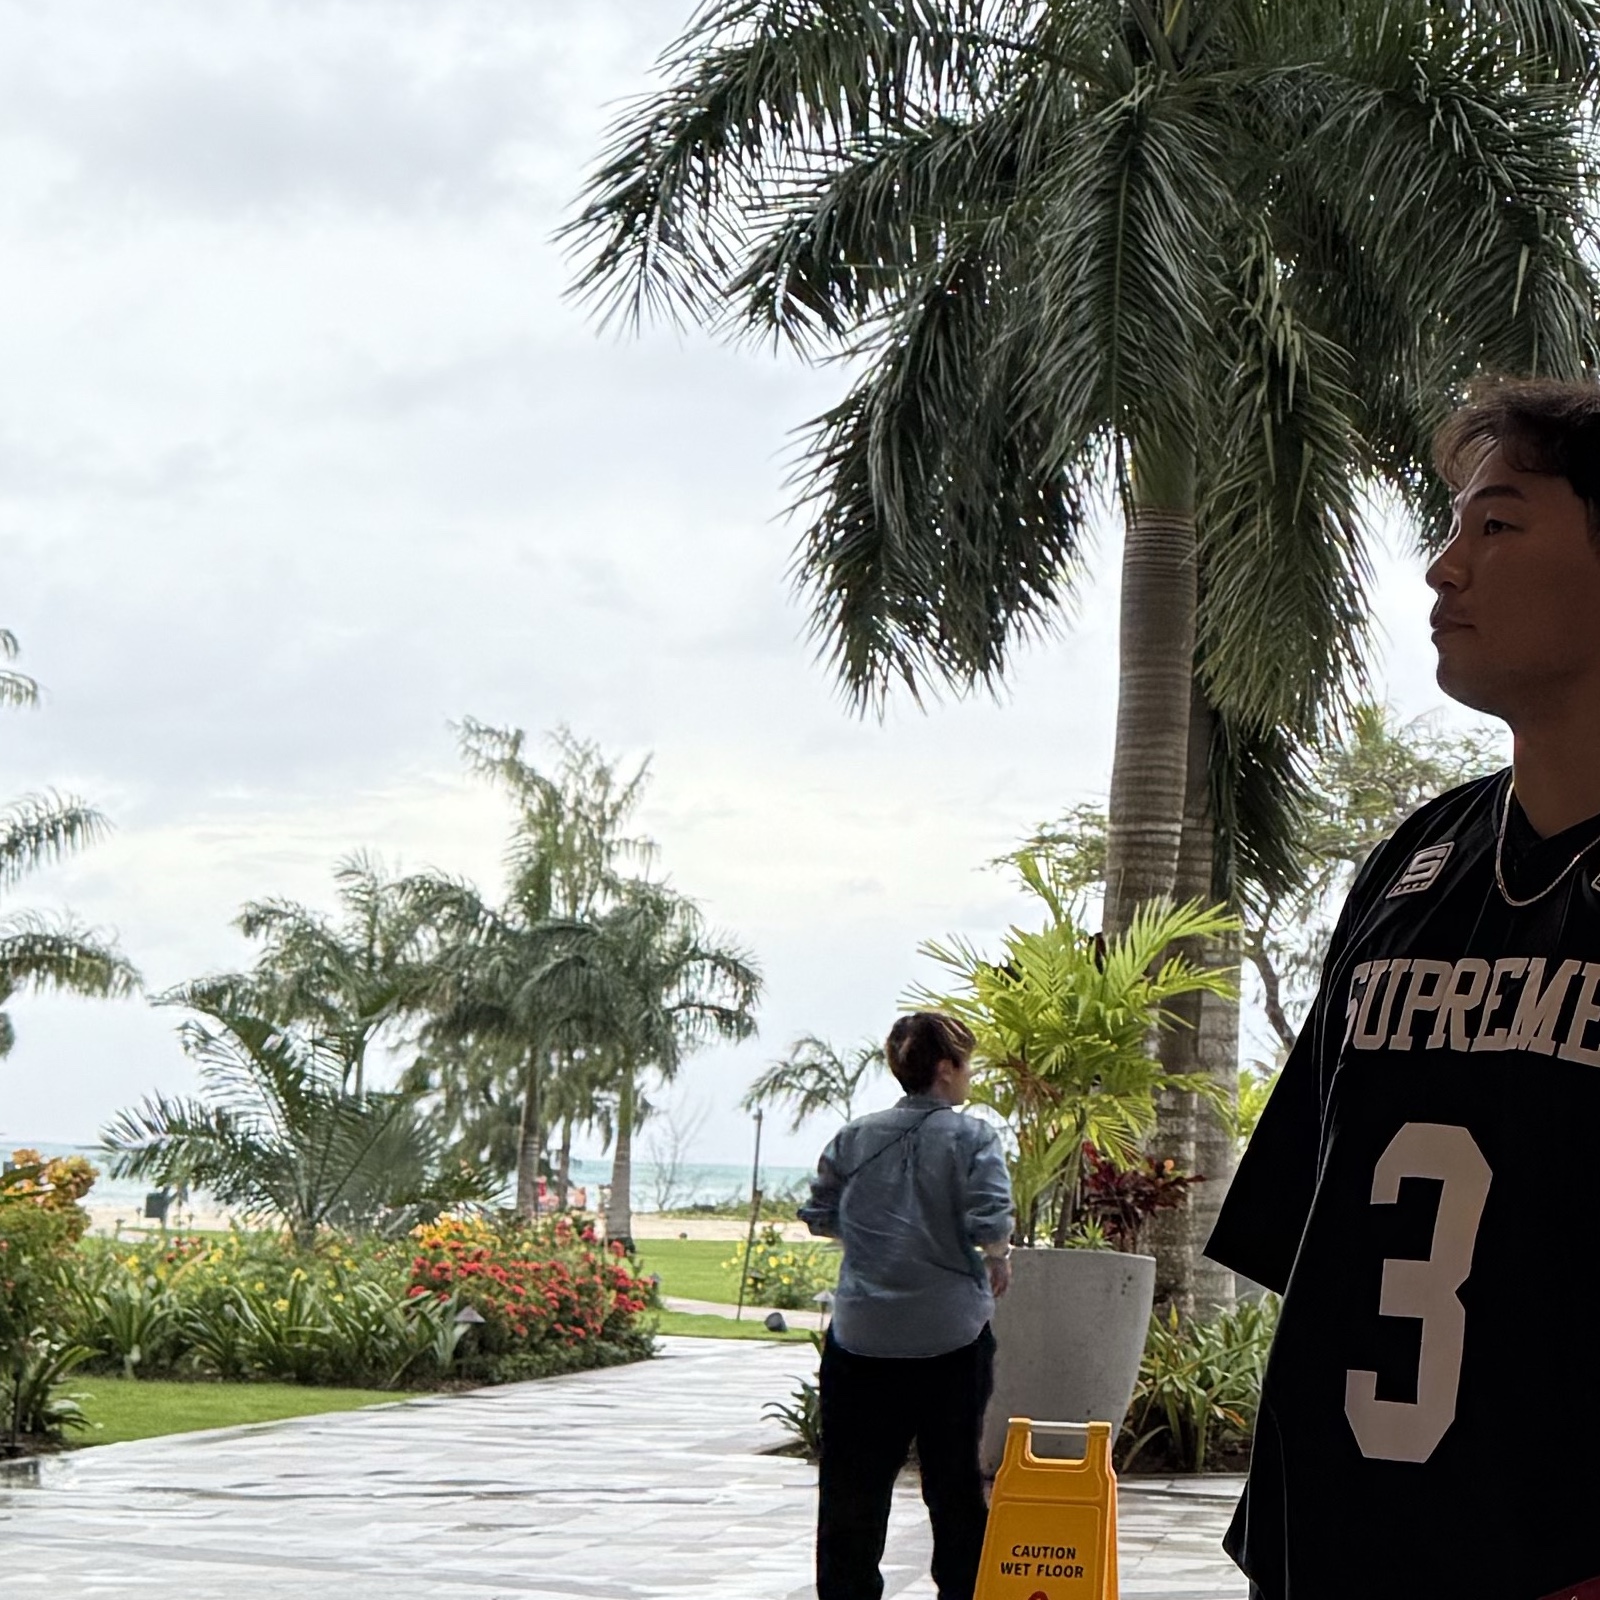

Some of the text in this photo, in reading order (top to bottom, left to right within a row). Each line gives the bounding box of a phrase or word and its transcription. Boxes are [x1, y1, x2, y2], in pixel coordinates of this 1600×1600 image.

[1345, 1122, 1493, 1463] 3
[1012, 1545, 1076, 1560] CAUTION
[1000, 1562, 1084, 1578] WET FLOOR
